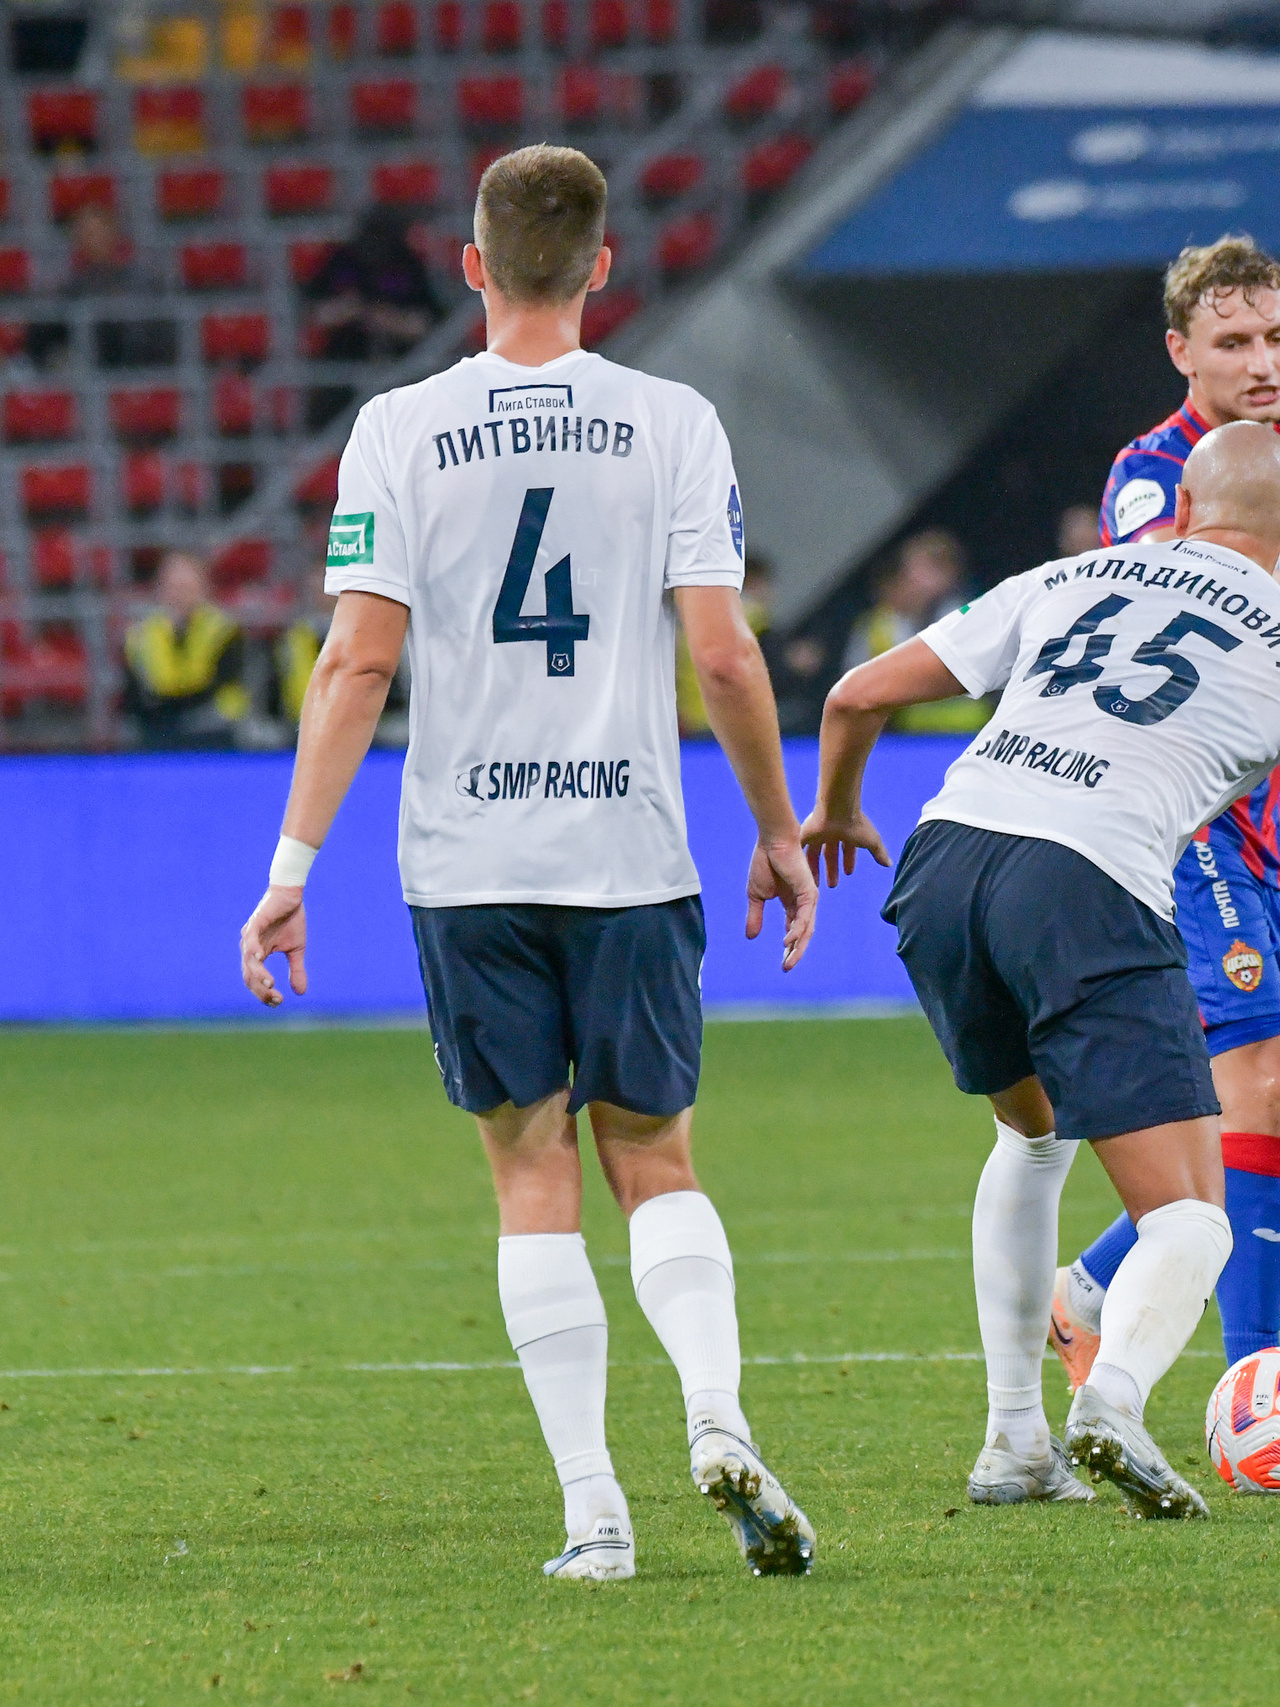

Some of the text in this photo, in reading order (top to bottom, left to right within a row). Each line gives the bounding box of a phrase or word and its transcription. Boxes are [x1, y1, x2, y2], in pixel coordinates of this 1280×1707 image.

[432, 416, 635, 471] ЛИТВИНОВ
[493, 487, 590, 677] 4
[1023, 592, 1244, 727] 45
[487, 759, 631, 800] SMP RACING
[1021, 741, 1111, 789] RACING
[1212, 880, 1240, 929] ПОЧТА
[598, 1526, 620, 1537] KING
